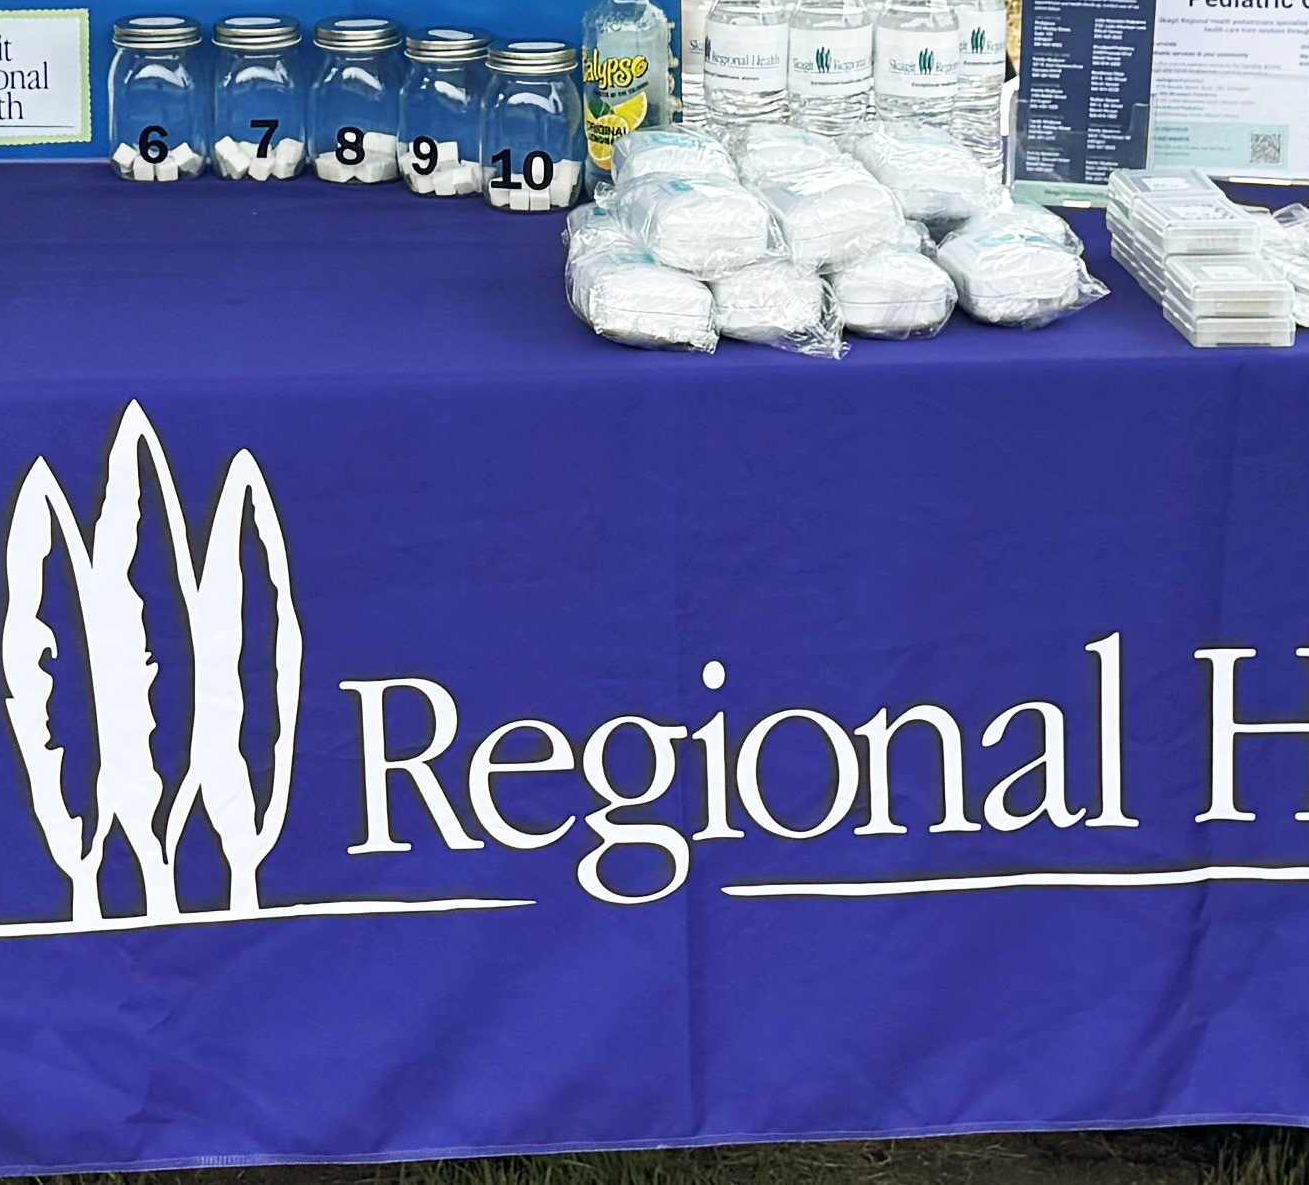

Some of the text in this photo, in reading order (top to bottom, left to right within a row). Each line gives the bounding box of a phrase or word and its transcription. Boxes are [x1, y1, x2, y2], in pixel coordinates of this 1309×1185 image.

[139, 125, 169, 164] 6
[250, 119, 279, 159] 7
[335, 126, 366, 165] 8
[412, 135, 438, 175] 9
[491, 148, 553, 191] 10
[341, 631, 1140, 905] Regional
